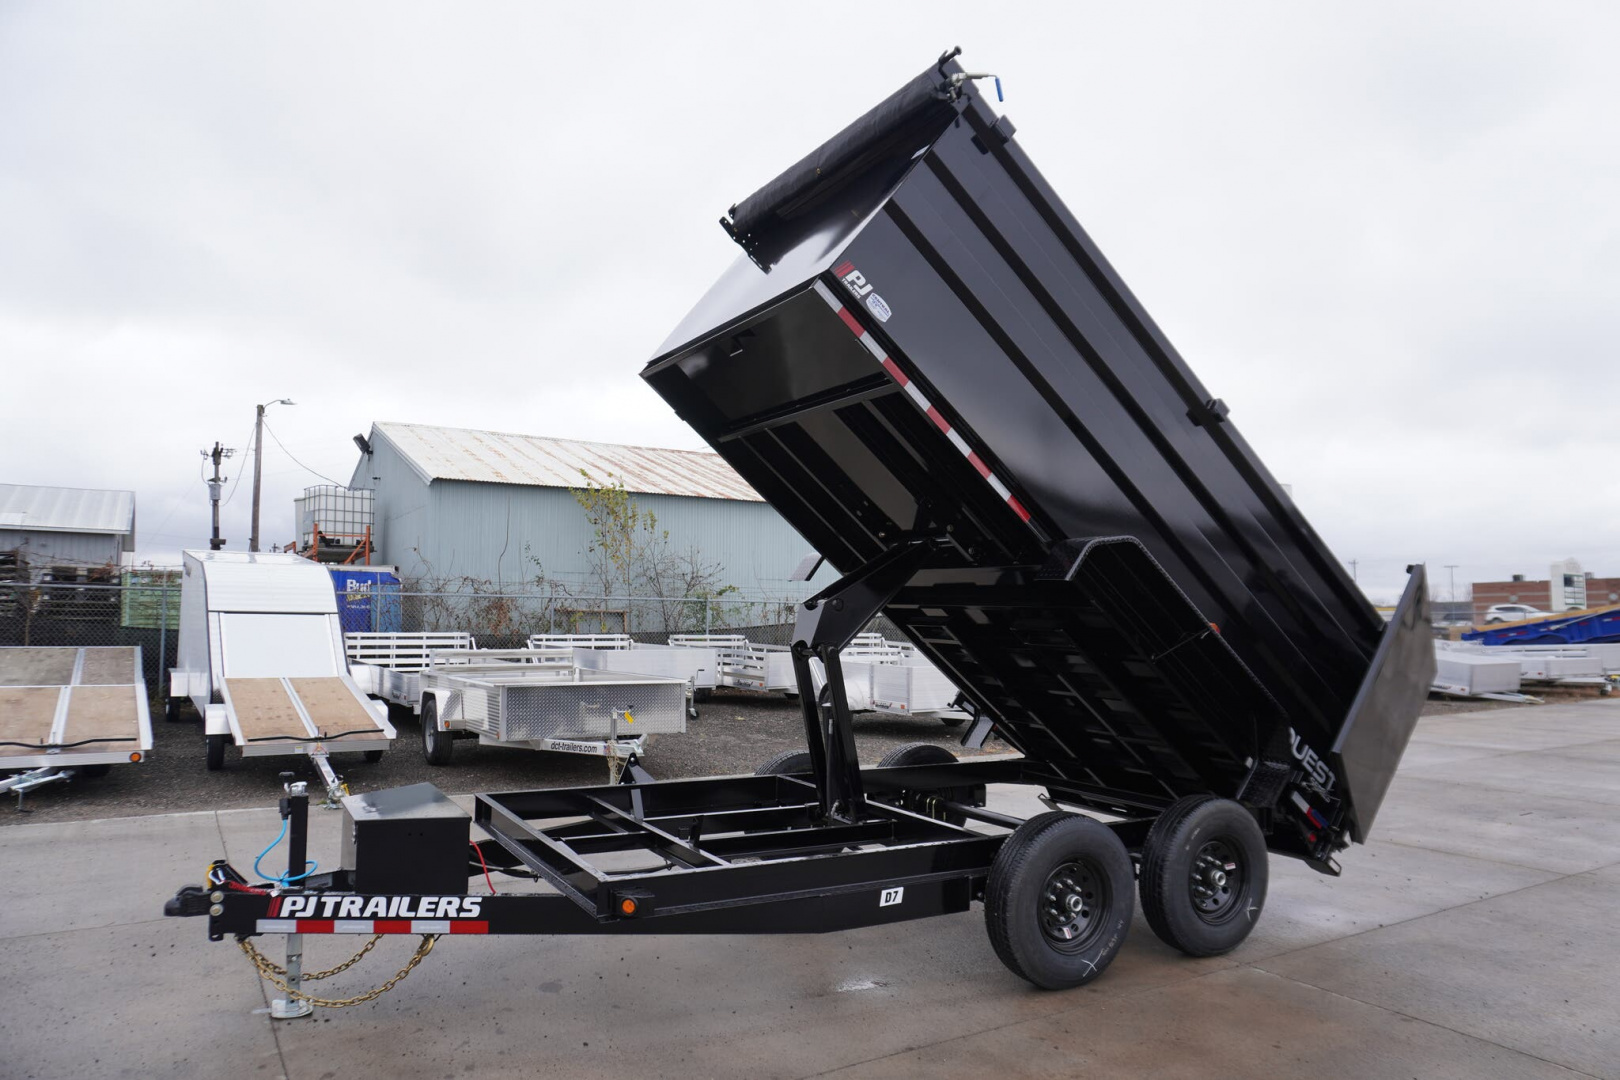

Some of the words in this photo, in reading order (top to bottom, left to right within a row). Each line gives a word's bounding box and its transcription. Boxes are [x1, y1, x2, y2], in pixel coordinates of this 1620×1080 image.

[845, 269, 874, 296] PJ
[550, 741, 598, 754] dct-trailers.com
[884, 890, 899, 904] D7
[279, 896, 318, 918] PJ
[320, 896, 483, 918] TRAILERS
